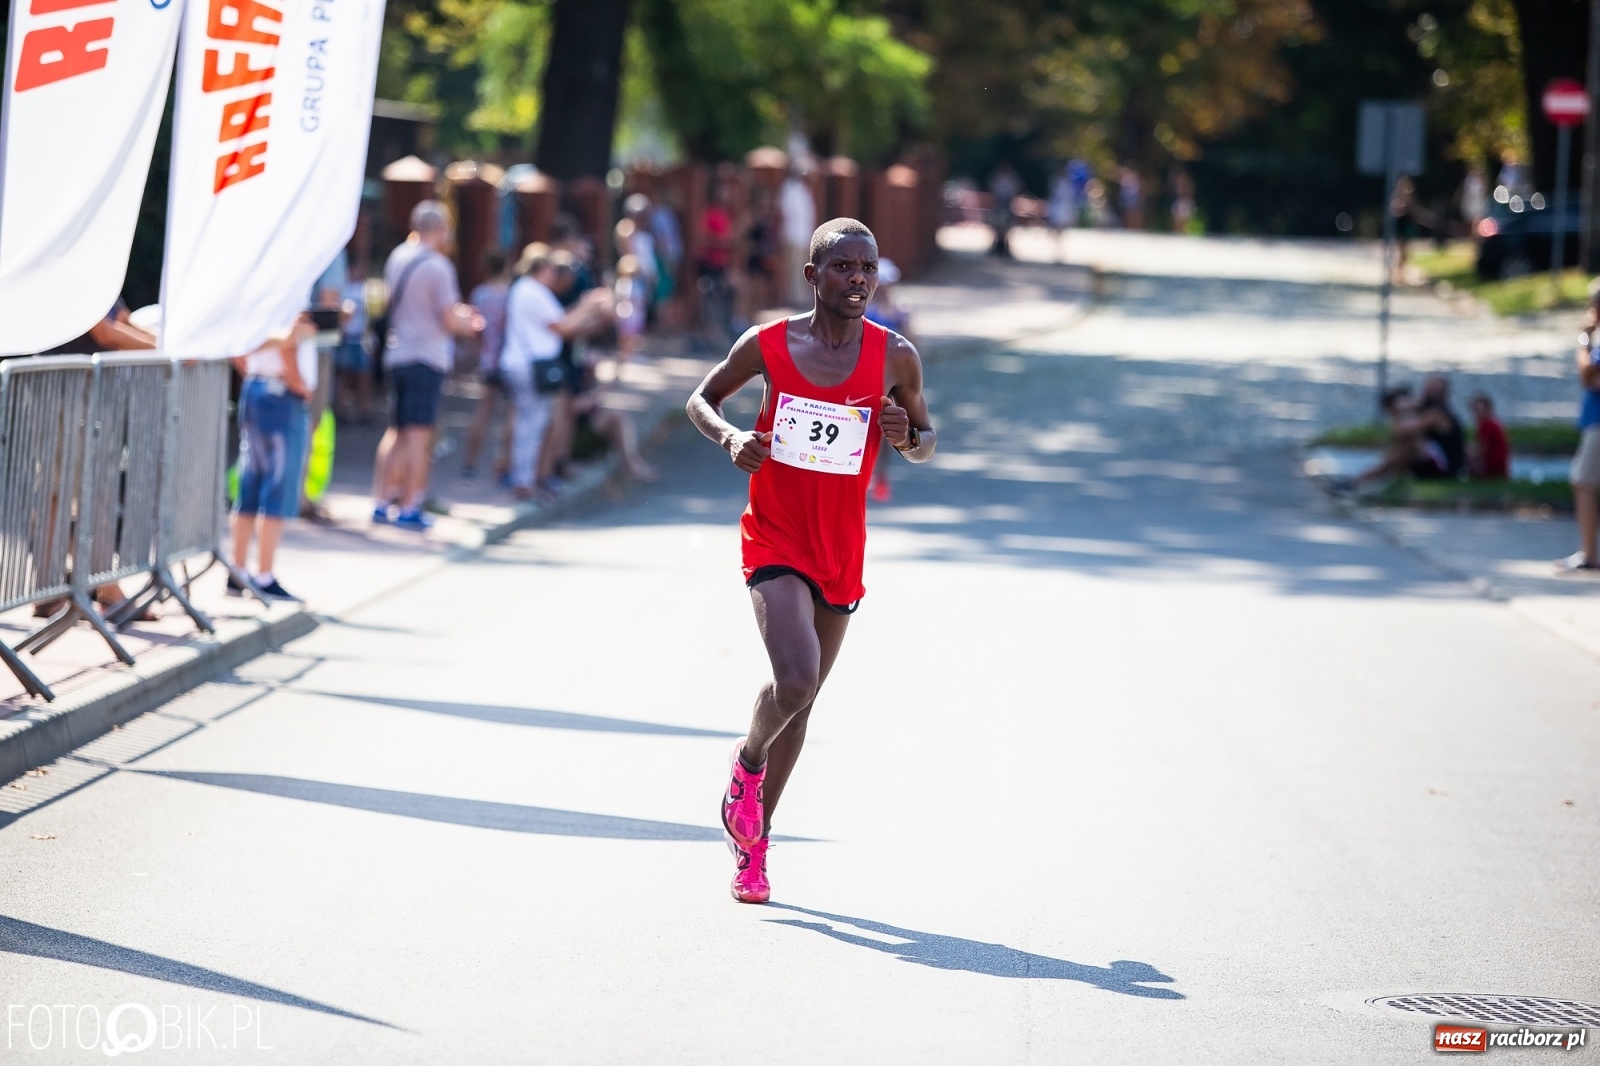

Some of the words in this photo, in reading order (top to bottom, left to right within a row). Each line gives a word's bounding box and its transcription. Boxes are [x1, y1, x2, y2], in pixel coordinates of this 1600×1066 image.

[202, 0, 286, 195] RAFA
[300, 37, 329, 133] GRUPA
[809, 420, 840, 446] 39
